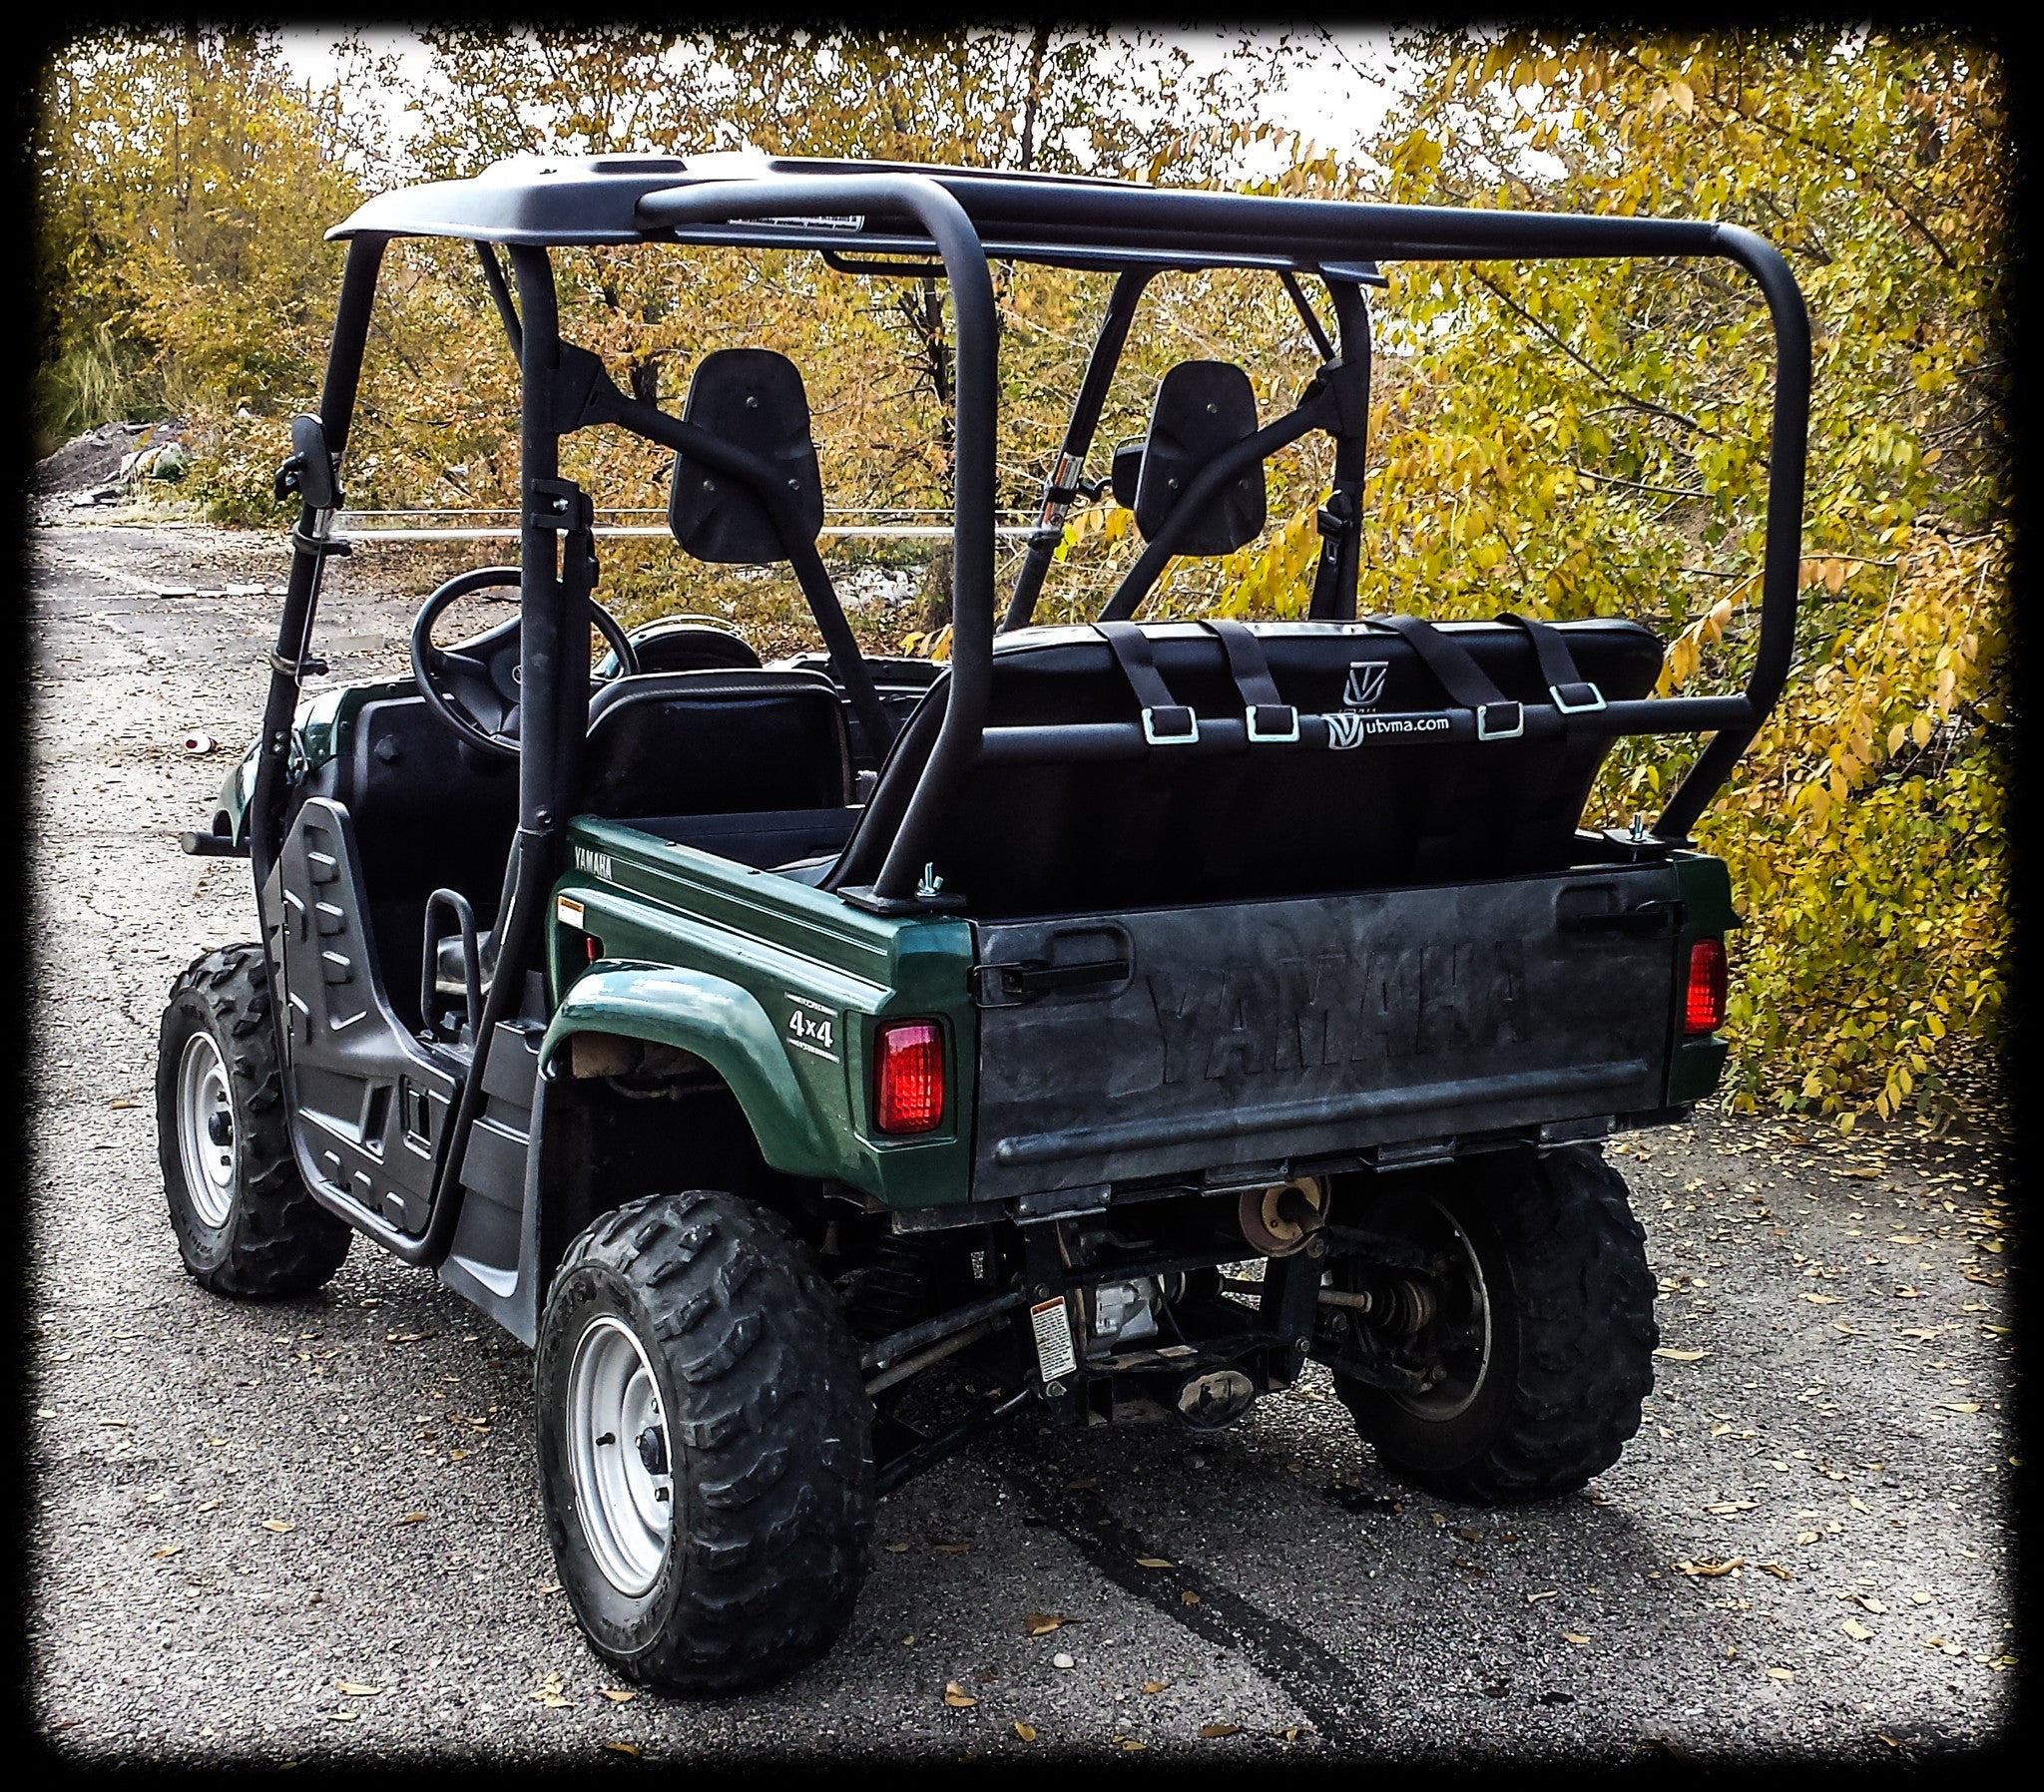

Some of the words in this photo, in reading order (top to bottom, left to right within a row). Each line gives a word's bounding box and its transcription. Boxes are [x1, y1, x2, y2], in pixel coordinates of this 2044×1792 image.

[1365, 717, 1450, 734] utvma.com
[574, 845, 613, 881] YAMAHA
[788, 1010, 834, 1049] 4x4
[1145, 940, 1531, 1085] YAMAHA
